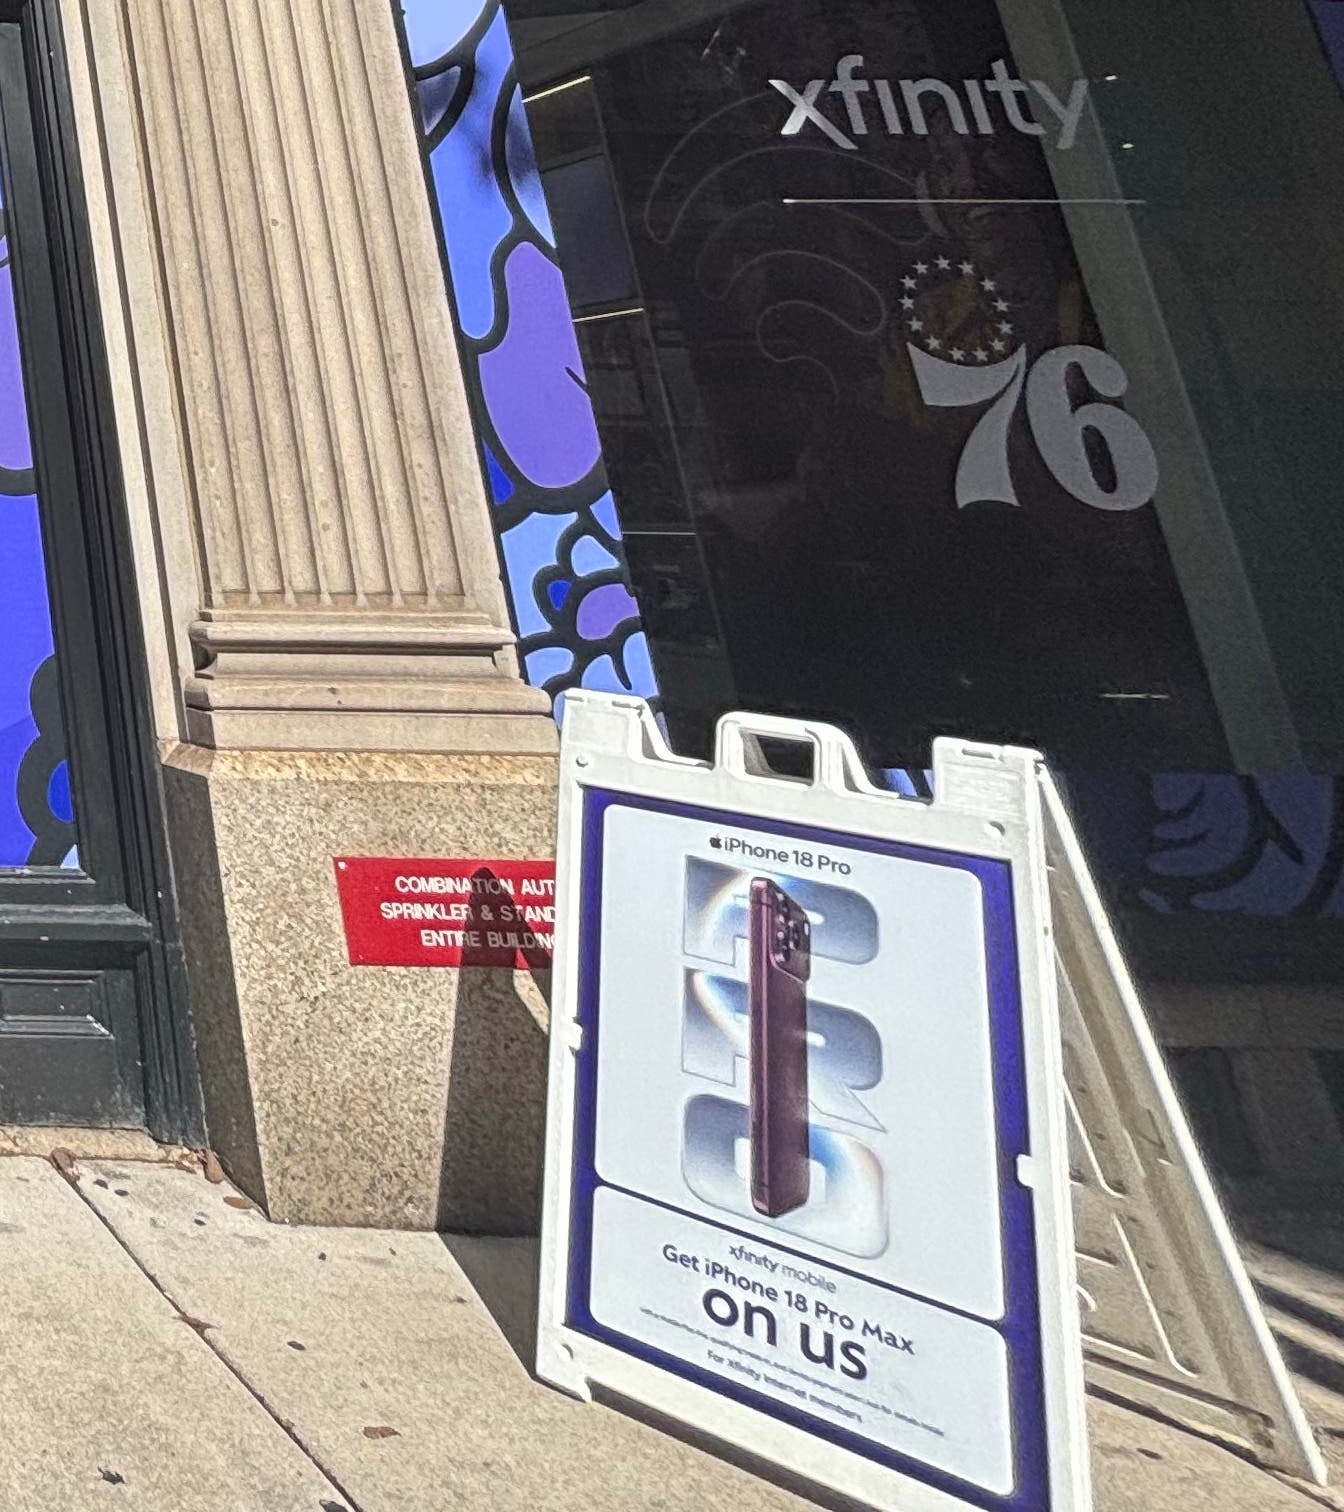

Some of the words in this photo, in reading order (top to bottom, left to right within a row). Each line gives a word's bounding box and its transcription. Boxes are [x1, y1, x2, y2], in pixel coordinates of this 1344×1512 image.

[768, 54, 1089, 149] xfinity
[906, 341, 1158, 511] 76
[724, 837, 789, 864] iPhone
[792, 849, 814, 869] 18
[817, 855, 852, 876] Pro
[395, 876, 515, 896] COMBINATION
[521, 878, 555, 896] AUT
[380, 902, 474, 921] SPRINKLER
[480, 904, 493, 921] &
[500, 904, 556, 923] STAND
[420, 929, 481, 948] ENTIRE
[728, 1245, 780, 1274] xfinity
[781, 1264, 838, 1294] mobile
[663, 1244, 700, 1273] Get
[705, 1257, 779, 1303] iPhone
[784, 1290, 808, 1313] 18
[815, 1299, 855, 1330] Pro
[861, 1318, 915, 1356] Max
[702, 1288, 778, 1347] on
[799, 1321, 868, 1381] us
